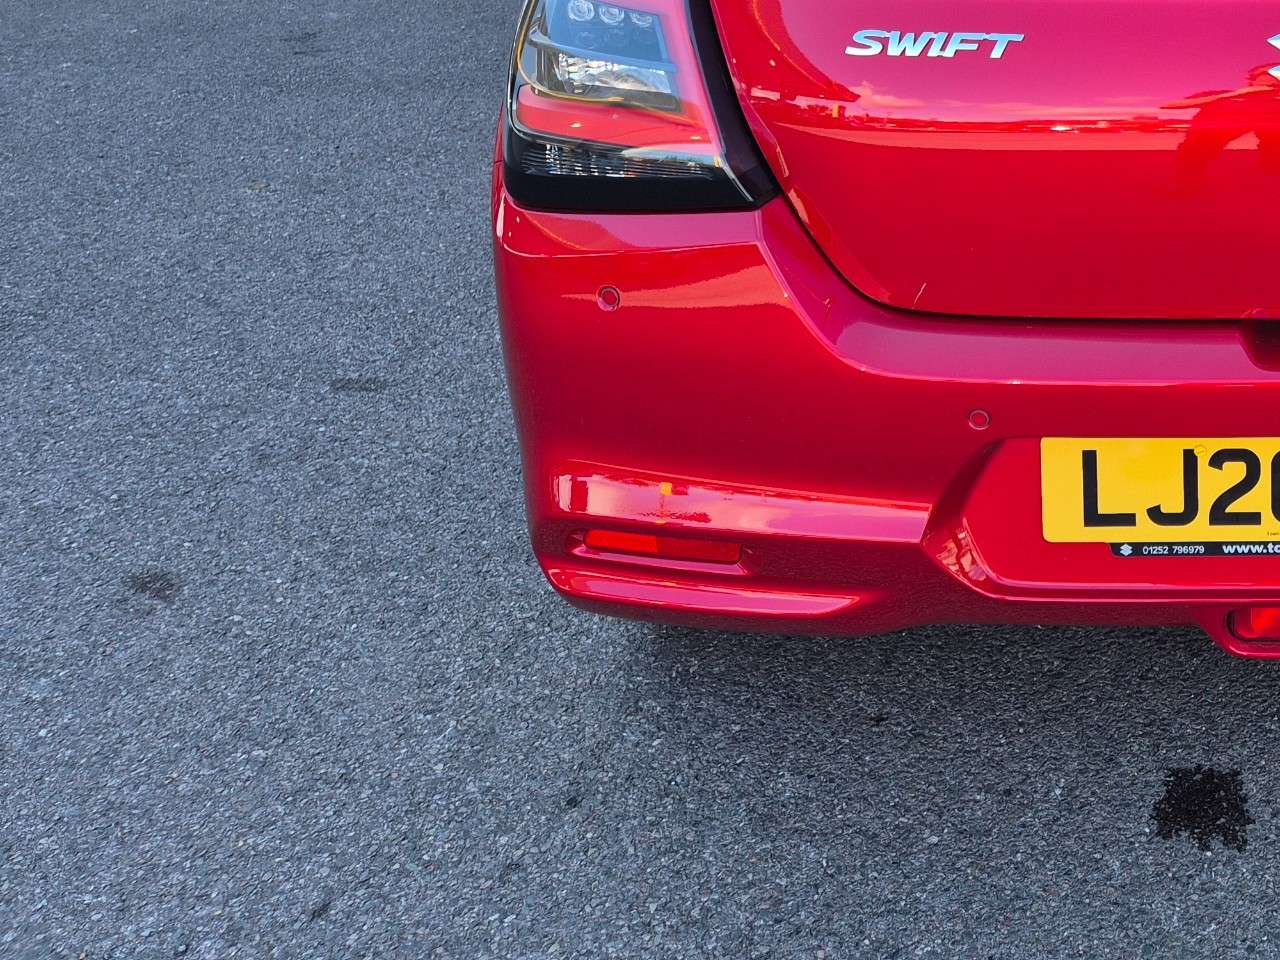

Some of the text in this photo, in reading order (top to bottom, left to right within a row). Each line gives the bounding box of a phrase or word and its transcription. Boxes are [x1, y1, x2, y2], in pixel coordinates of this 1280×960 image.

[845, 29, 1025, 59] SWIFT
[1142, 545, 1169, 555] 01252
[1172, 545, 1205, 555] 796979
